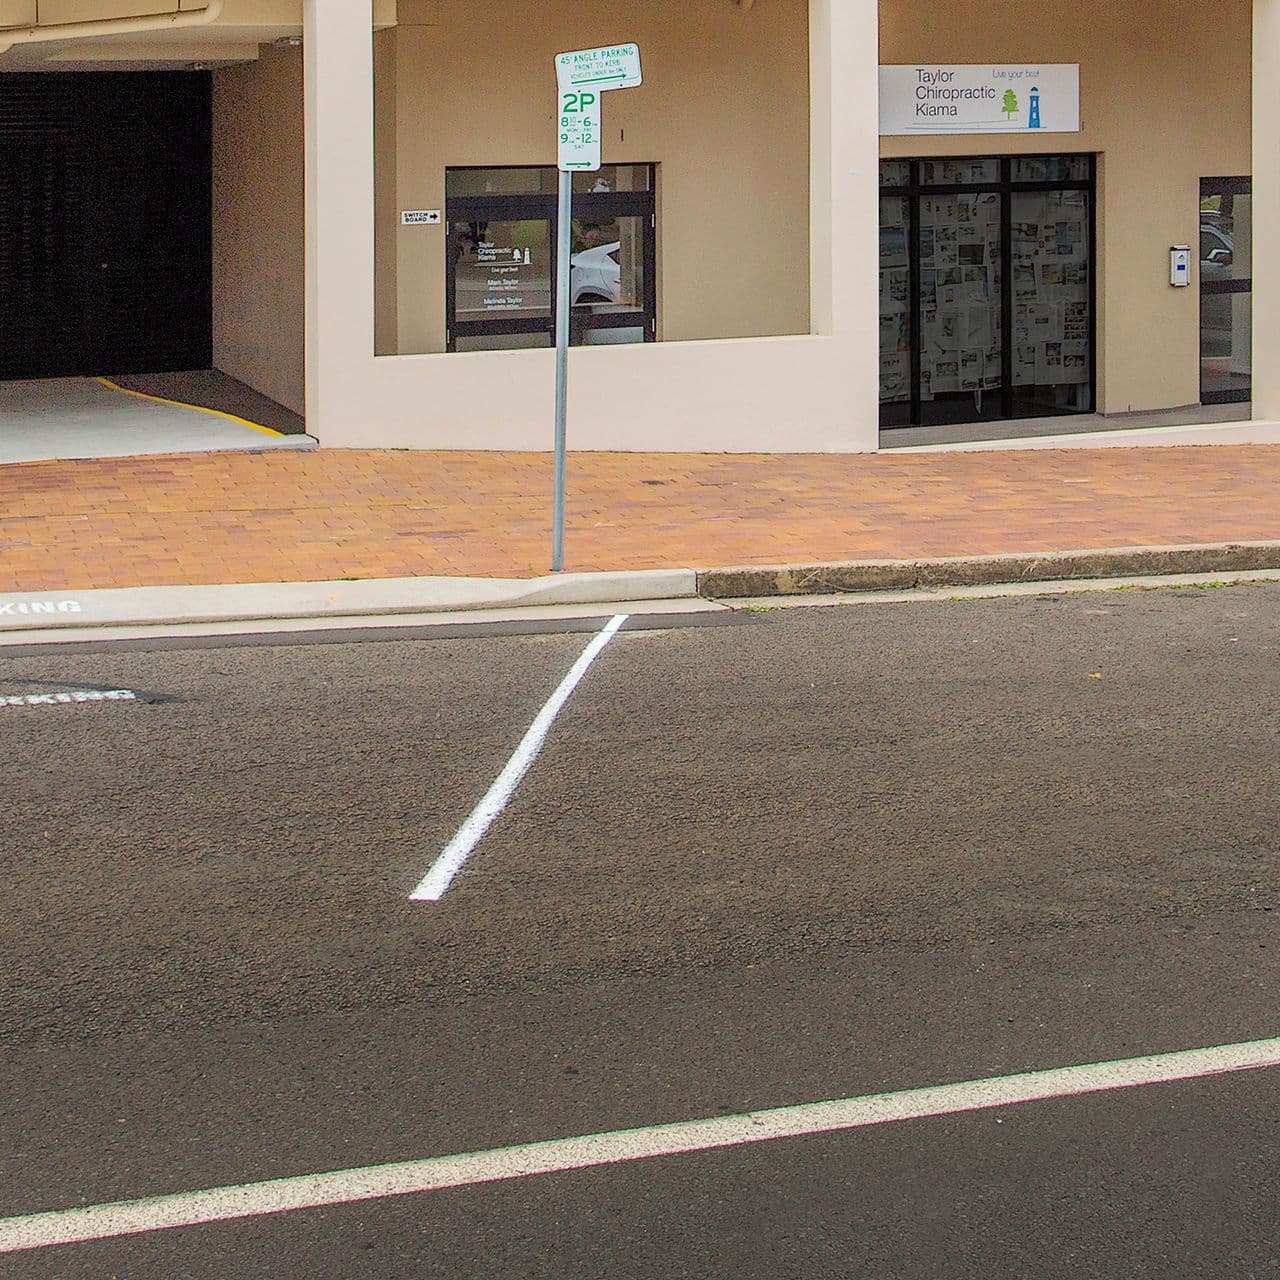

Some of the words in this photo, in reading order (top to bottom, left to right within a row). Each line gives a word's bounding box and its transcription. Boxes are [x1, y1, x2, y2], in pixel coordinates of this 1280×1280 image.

[574, 52, 598, 63] ANGLE
[601, 47, 633, 58] PARKING
[915, 68, 955, 85] Taylor
[1008, 71, 1024, 80] your
[915, 86, 997, 101] Chiropractic
[563, 93, 595, 113] 2P
[915, 103, 958, 116] Kiama
[478, 241, 495, 249] Taylor
